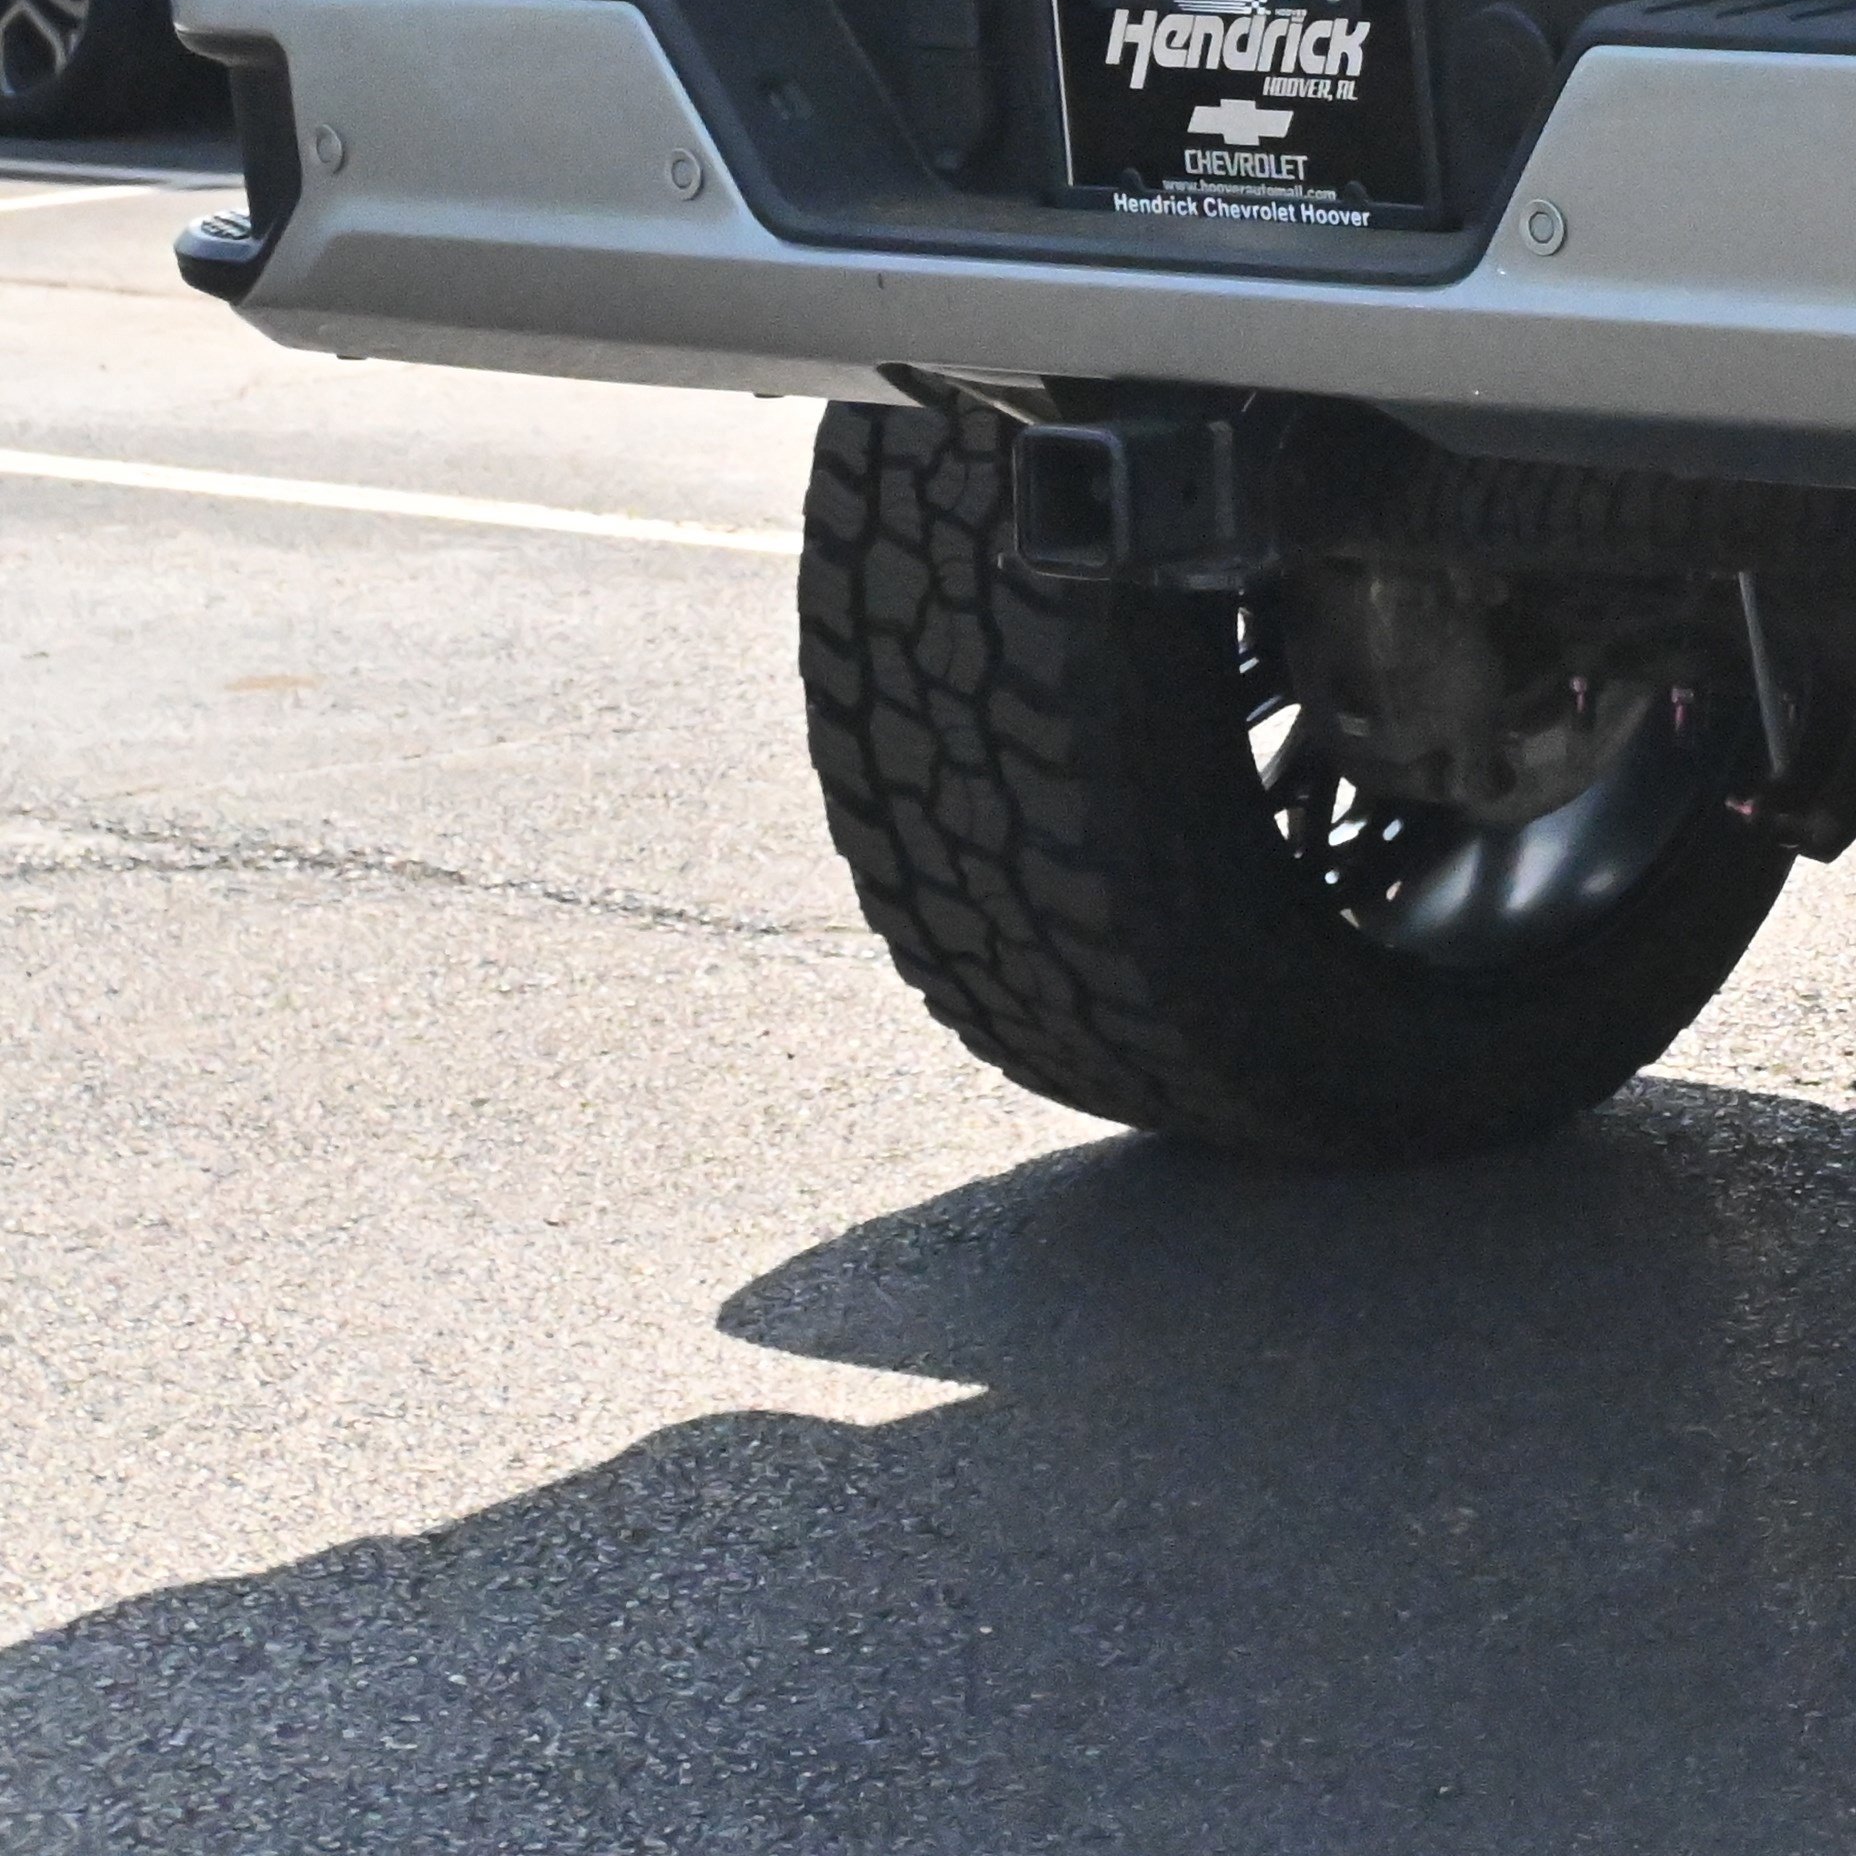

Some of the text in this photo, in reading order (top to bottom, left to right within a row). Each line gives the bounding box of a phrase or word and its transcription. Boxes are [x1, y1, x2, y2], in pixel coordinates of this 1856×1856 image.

[1105, 9, 1371, 89] Hendrick
[1262, 76, 1359, 102] HOOVER, AL
[1184, 149, 1308, 181] CHEVROLET
[1113, 192, 1371, 227] Hendrick Chevrolet Hoover
